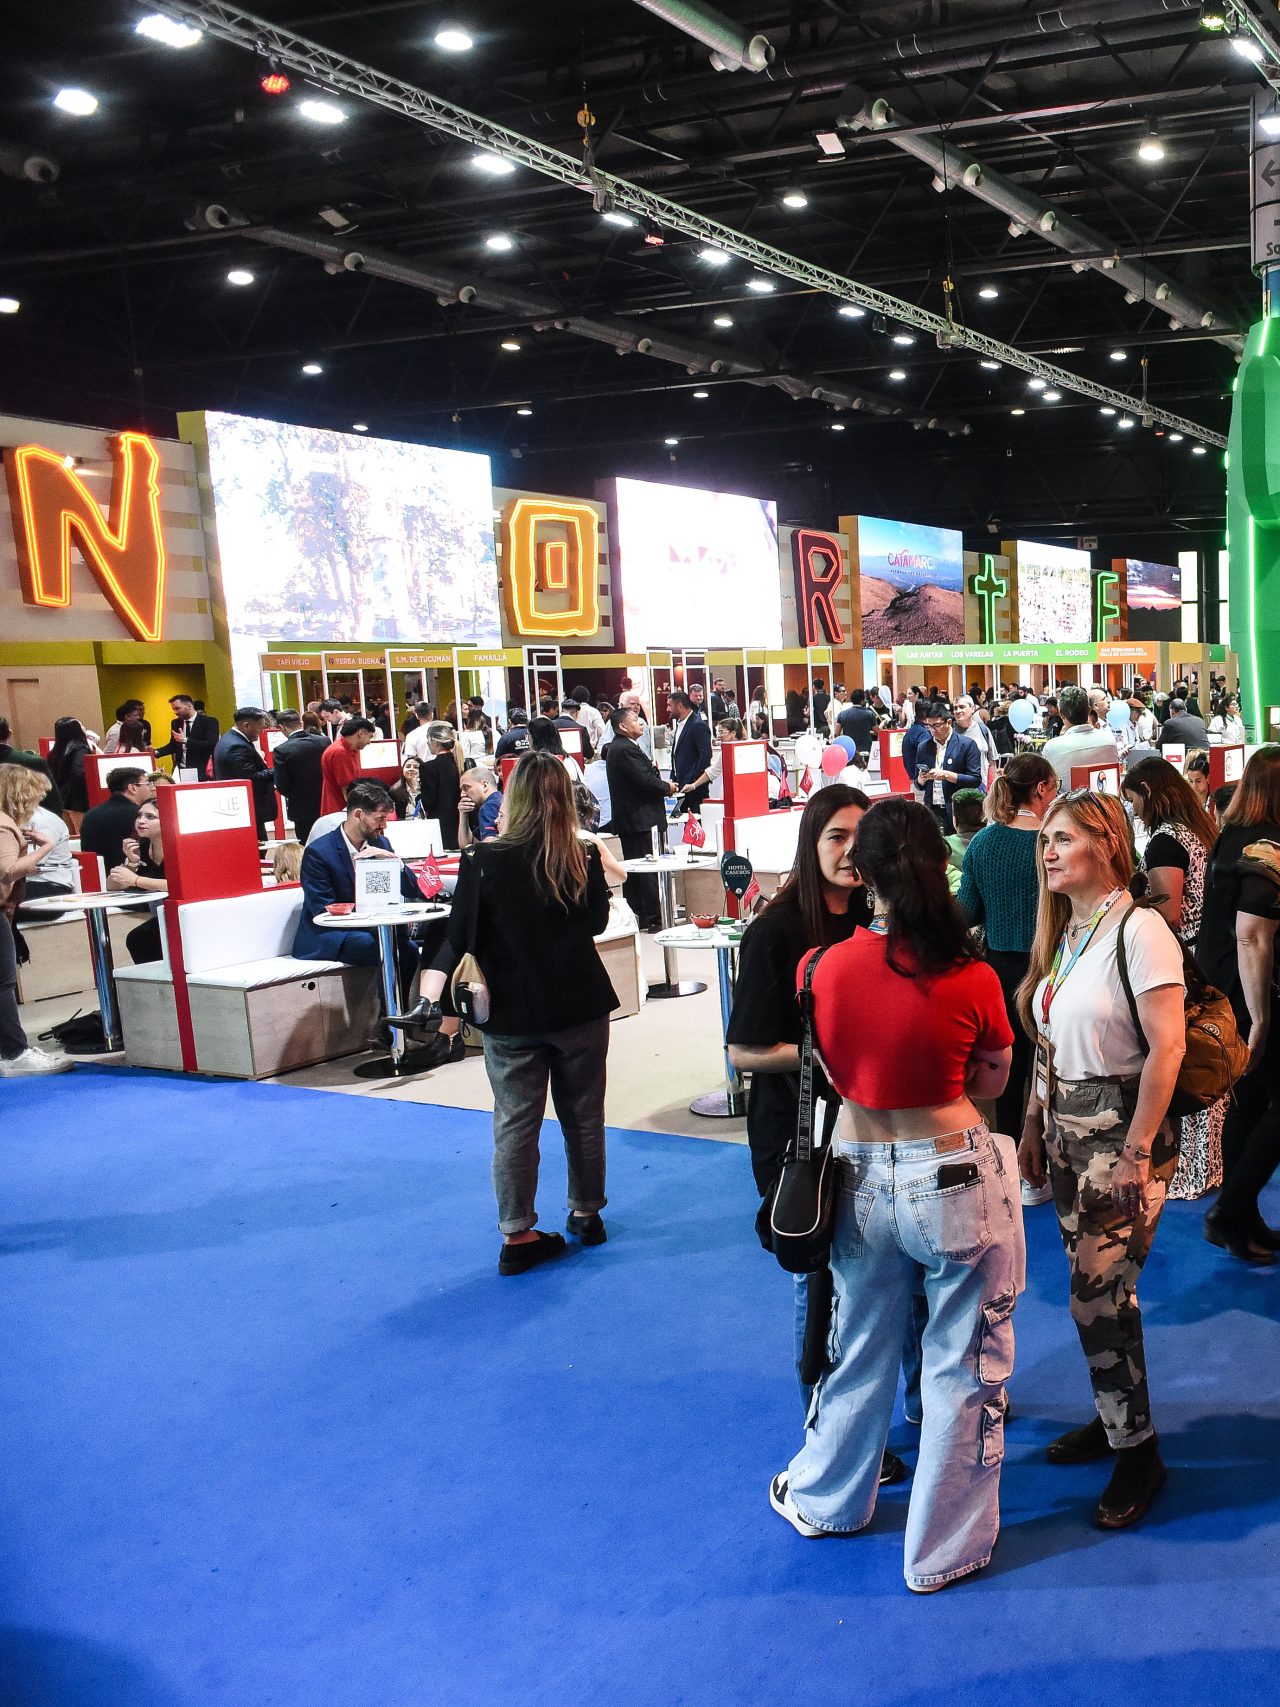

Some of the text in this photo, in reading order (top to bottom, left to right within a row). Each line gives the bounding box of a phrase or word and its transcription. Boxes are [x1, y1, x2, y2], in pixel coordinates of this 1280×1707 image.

[335, 656, 380, 665] YERBA BUENA
[409, 655, 419, 663] DE
[473, 651, 508, 662] FAMAILLÁ
[291, 658, 310, 666] VIEJO
